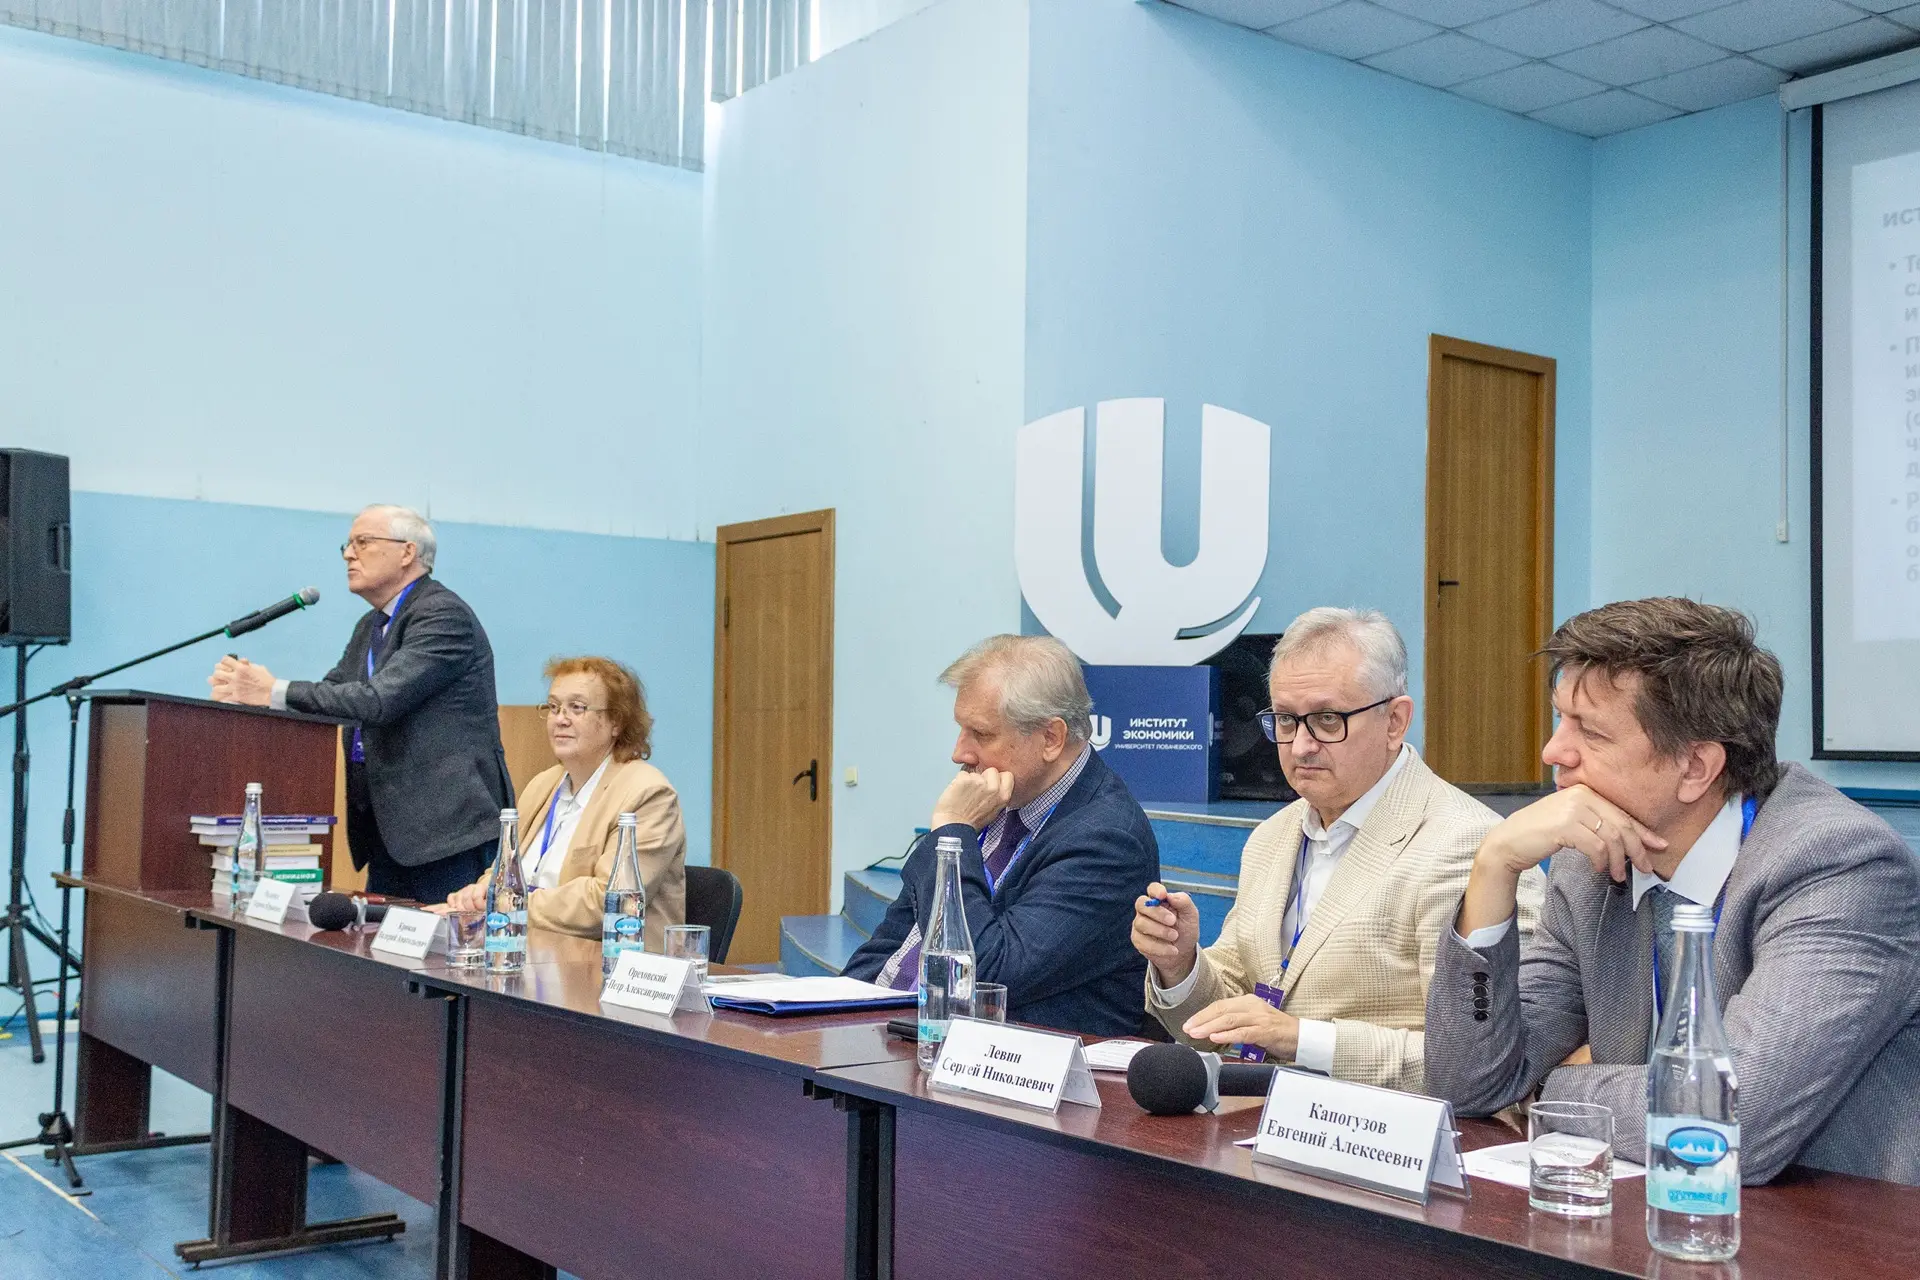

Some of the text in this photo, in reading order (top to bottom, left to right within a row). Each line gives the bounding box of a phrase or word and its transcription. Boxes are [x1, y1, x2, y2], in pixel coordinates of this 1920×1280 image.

[1129, 717, 1188, 728] ИНСТИТУТ
[1122, 730, 1194, 740] ЭКОНОМИКИ
[628, 966, 667, 983] Ореховский
[608, 981, 676, 1002] Петр Александрович
[984, 1043, 1022, 1064] Левин
[942, 1055, 1055, 1094] Сергей Николаевич
[1308, 1101, 1388, 1135] Капогузов
[1266, 1118, 1424, 1171] Евгений Алексеевич
